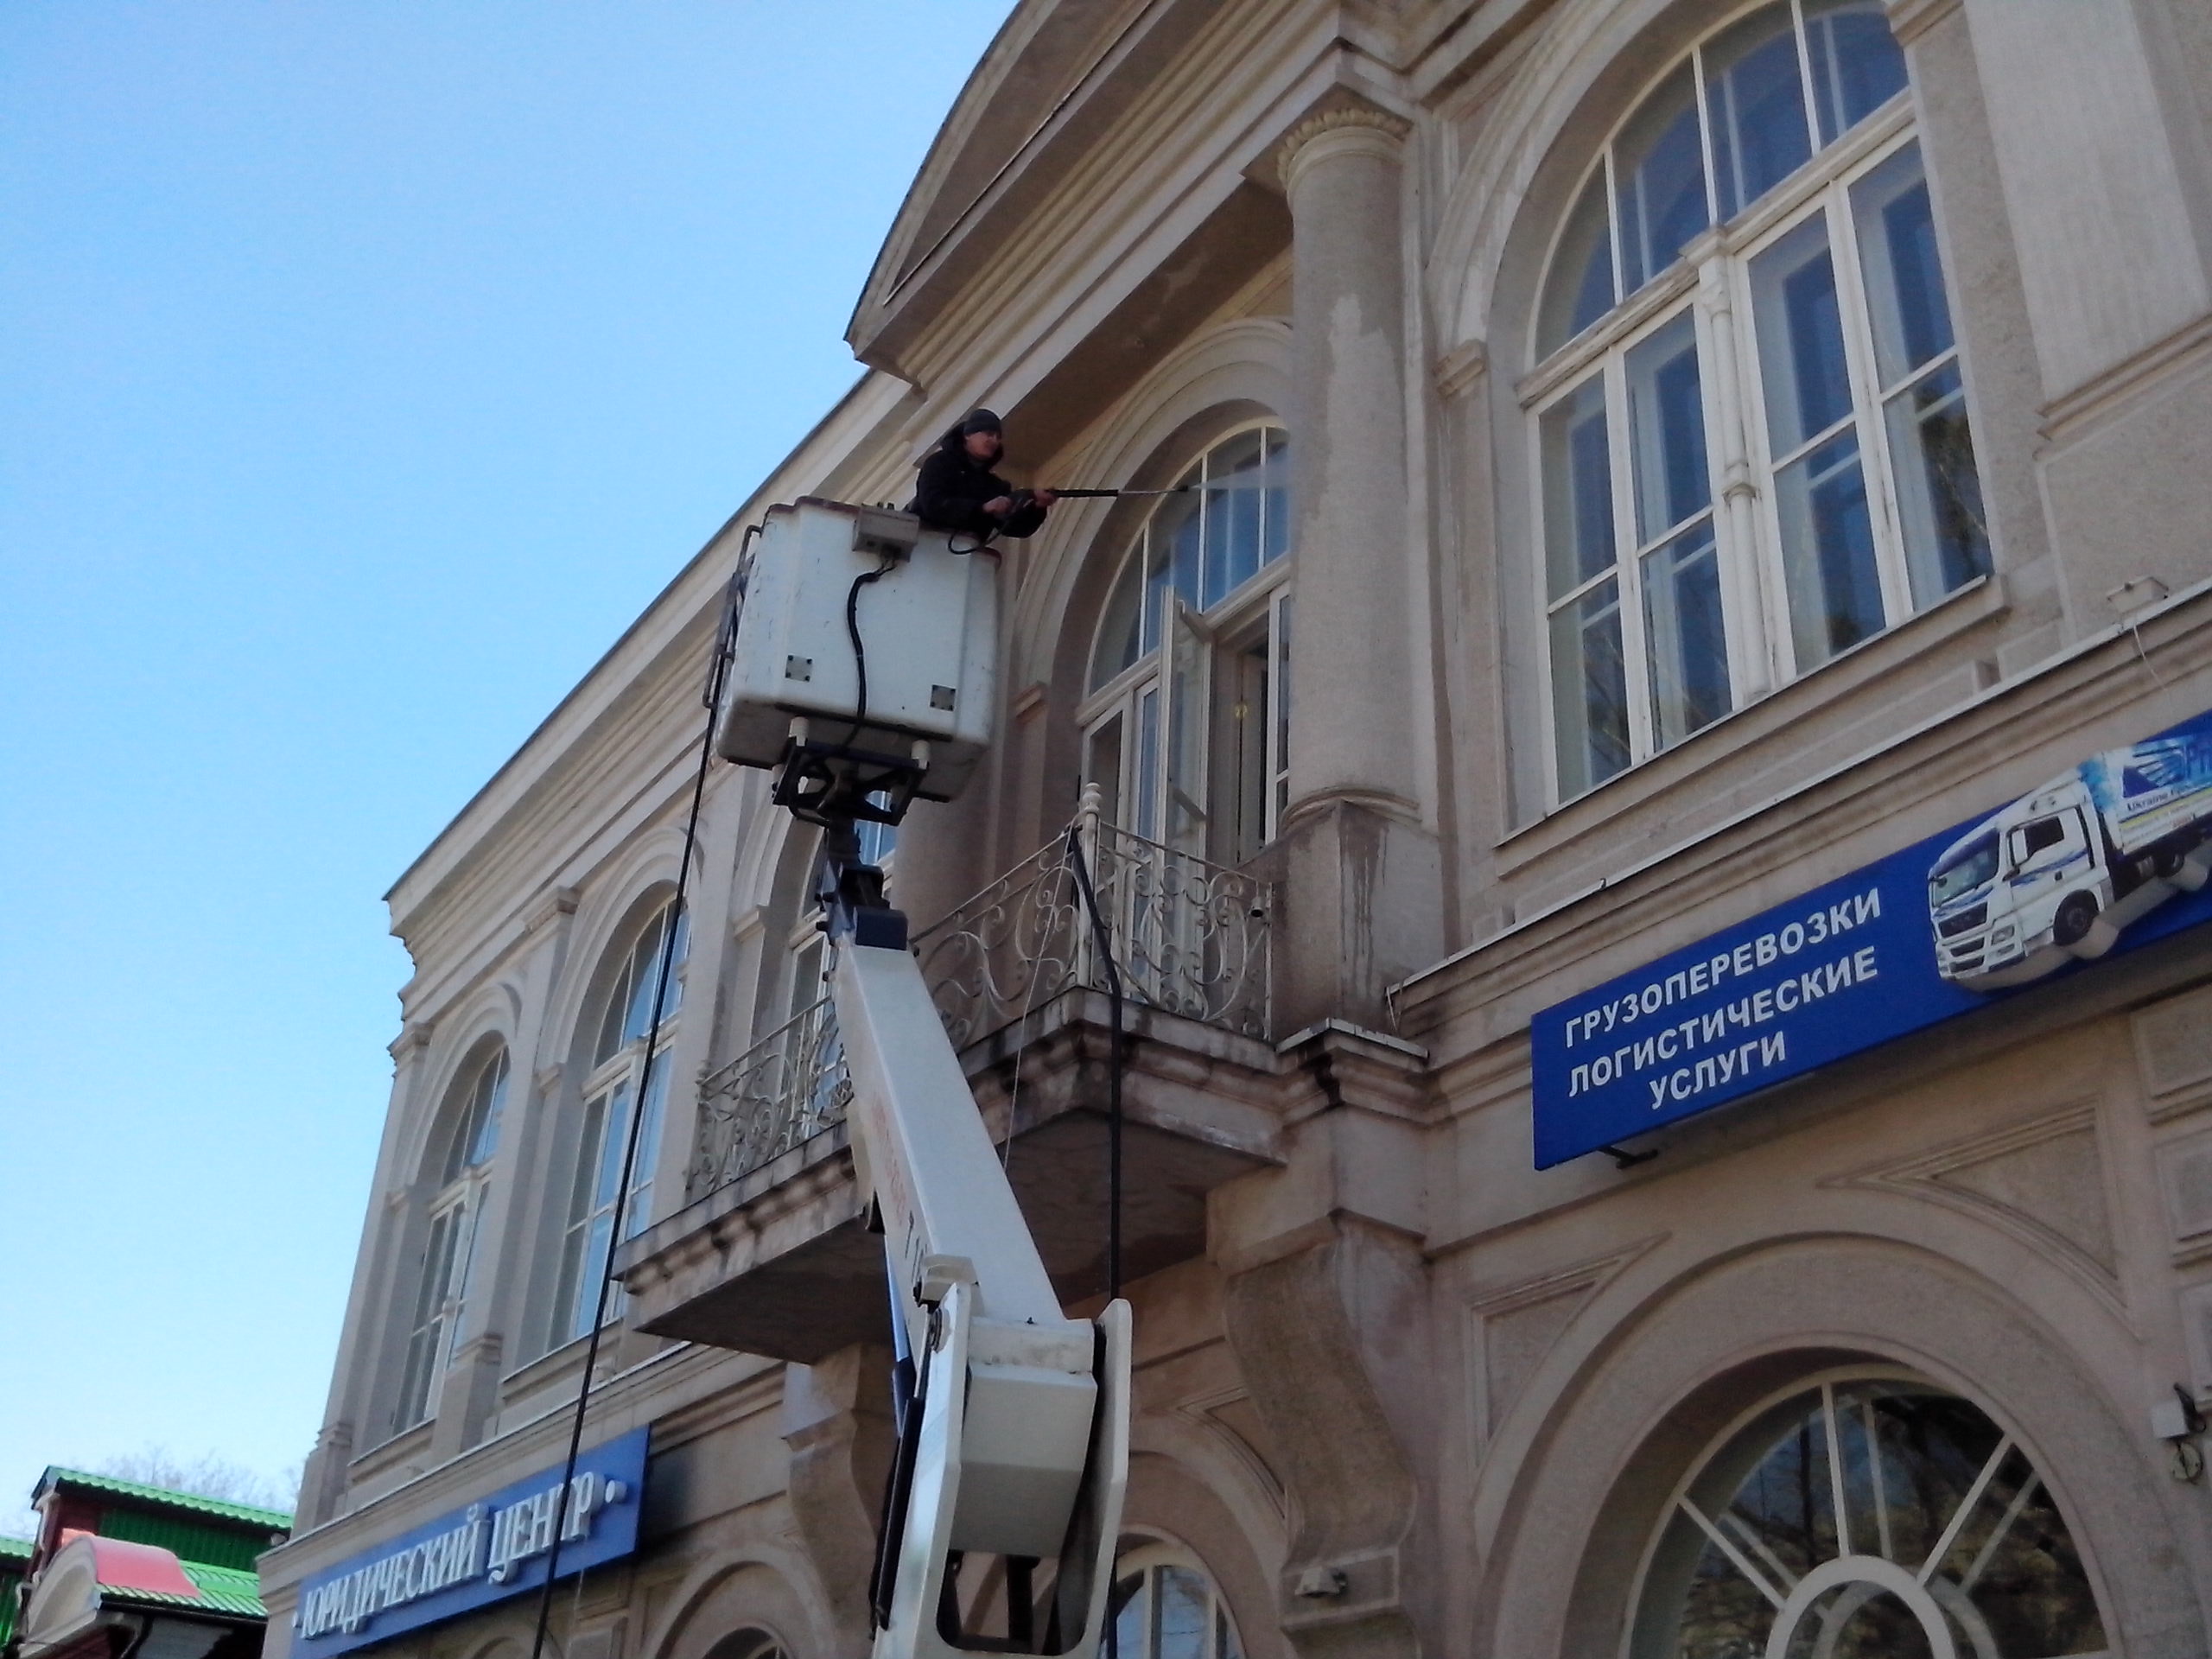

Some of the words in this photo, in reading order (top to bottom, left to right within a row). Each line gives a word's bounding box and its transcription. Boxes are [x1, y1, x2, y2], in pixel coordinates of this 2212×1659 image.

[1565, 887, 1881, 1048] ГРУЗОПЕРЕВОЗКИ
[1568, 945, 1878, 1097] ЛОГИСТИЧЕСКИЕ
[1649, 1031, 1786, 1110] УСЛУГИ
[301, 1503, 486, 1638] ЮРИДИЧЕСКИЙ
